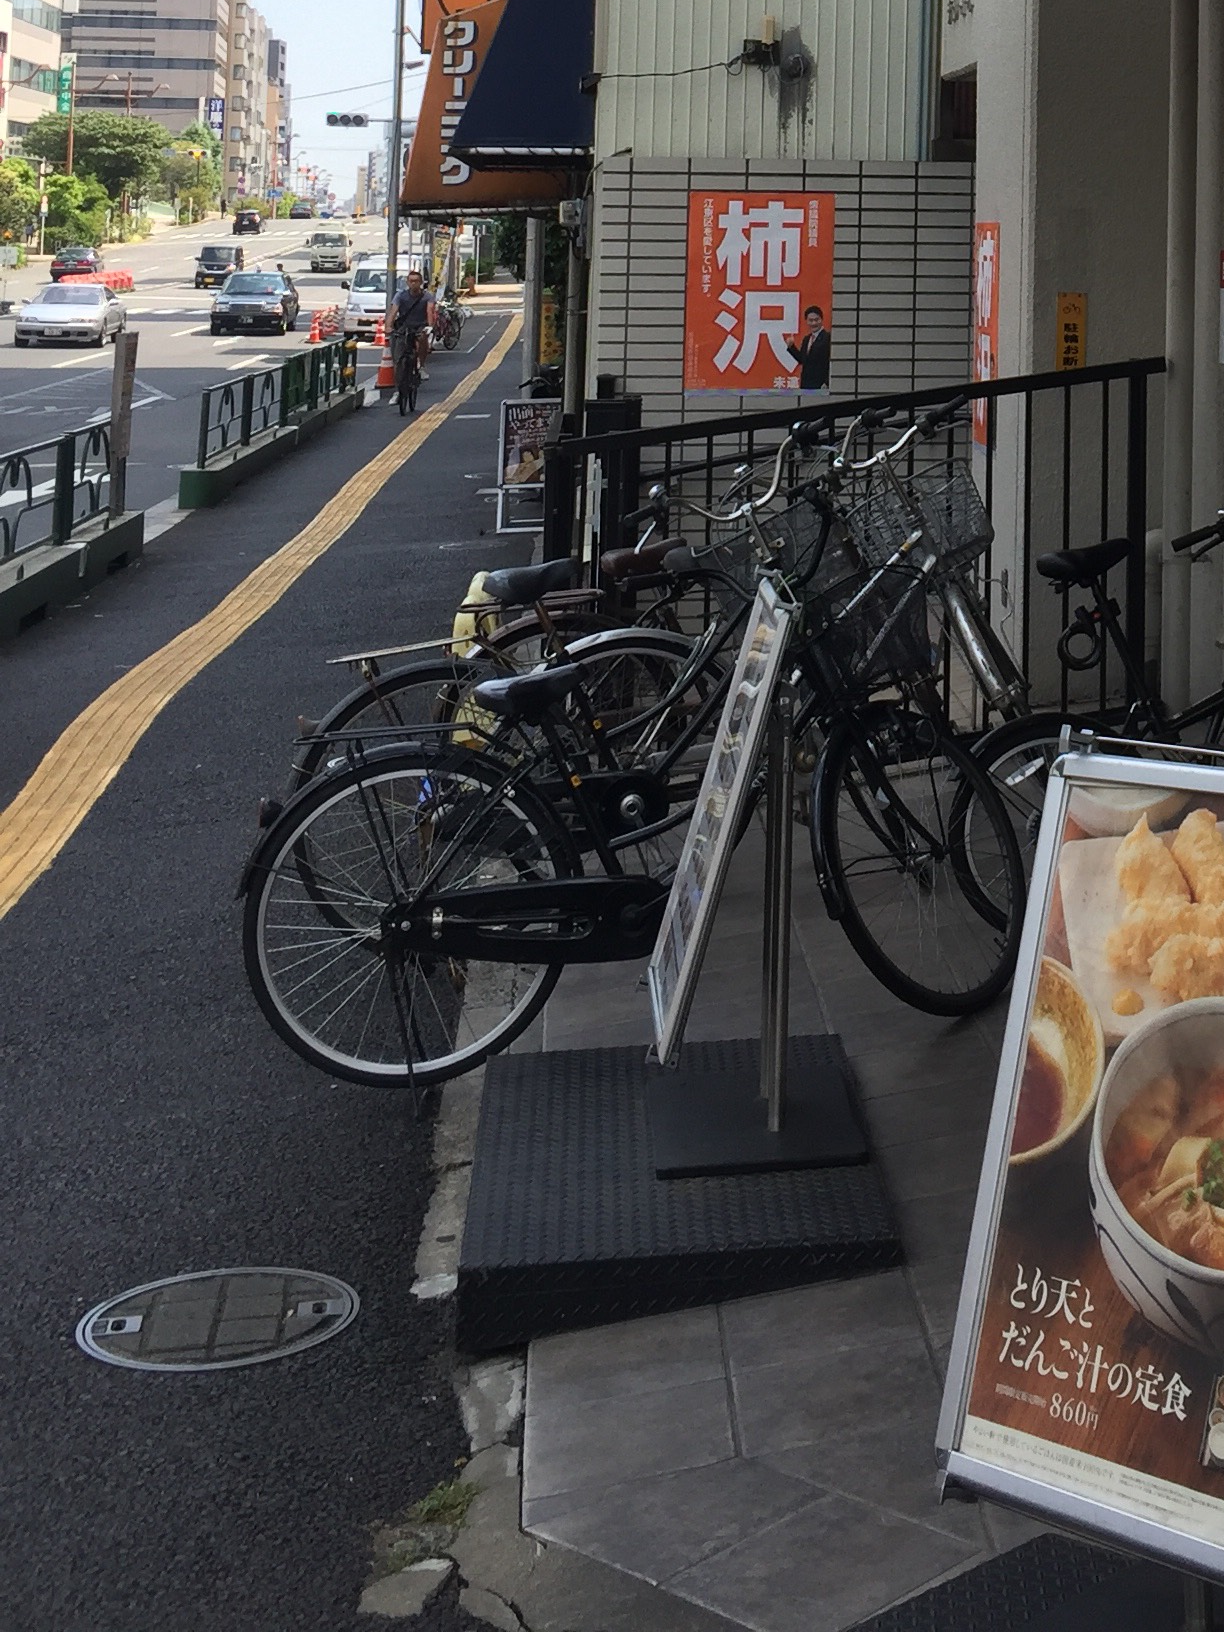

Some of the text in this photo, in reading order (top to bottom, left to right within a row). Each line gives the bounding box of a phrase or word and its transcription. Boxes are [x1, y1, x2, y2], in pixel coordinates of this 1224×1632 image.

[712, 199, 805, 374] 柿沢
[1061, 322, 1080, 371] 駐輪お断
[1010, 1262, 1095, 1329] とり天と
[999, 1320, 1193, 1422] だんご汁の定食
